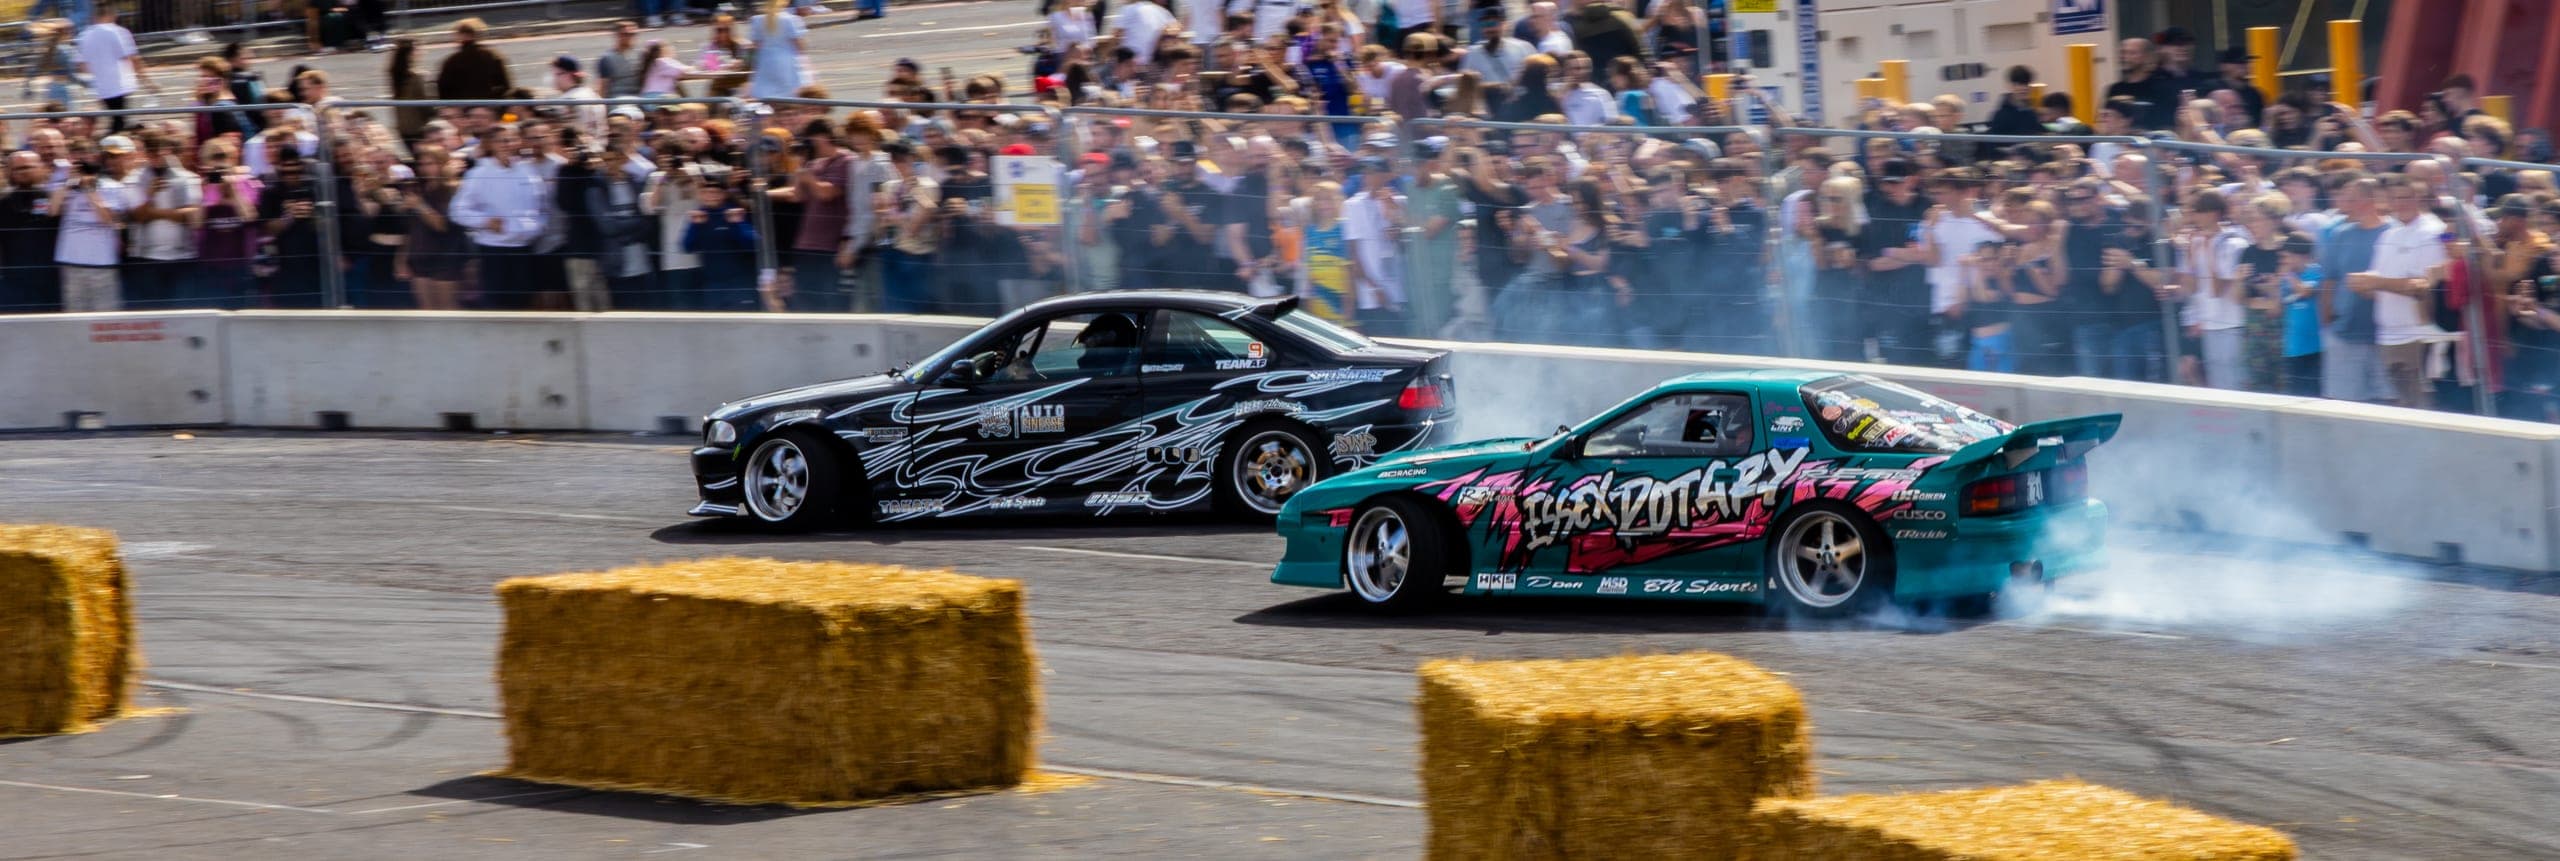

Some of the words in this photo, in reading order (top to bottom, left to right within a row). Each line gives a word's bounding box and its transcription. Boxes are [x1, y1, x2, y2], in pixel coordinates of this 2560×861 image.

[1021, 404, 1065, 417] AUTO
[1020, 416, 1066, 432] FINESSE
[1396, 467, 1427, 478] RACING
[1893, 509, 1947, 521] CUSCO
[1477, 573, 1517, 589] HKS
[1600, 576, 1629, 588] MSD
[1643, 578, 1682, 594] BN
[1685, 579, 1758, 595] Sports
